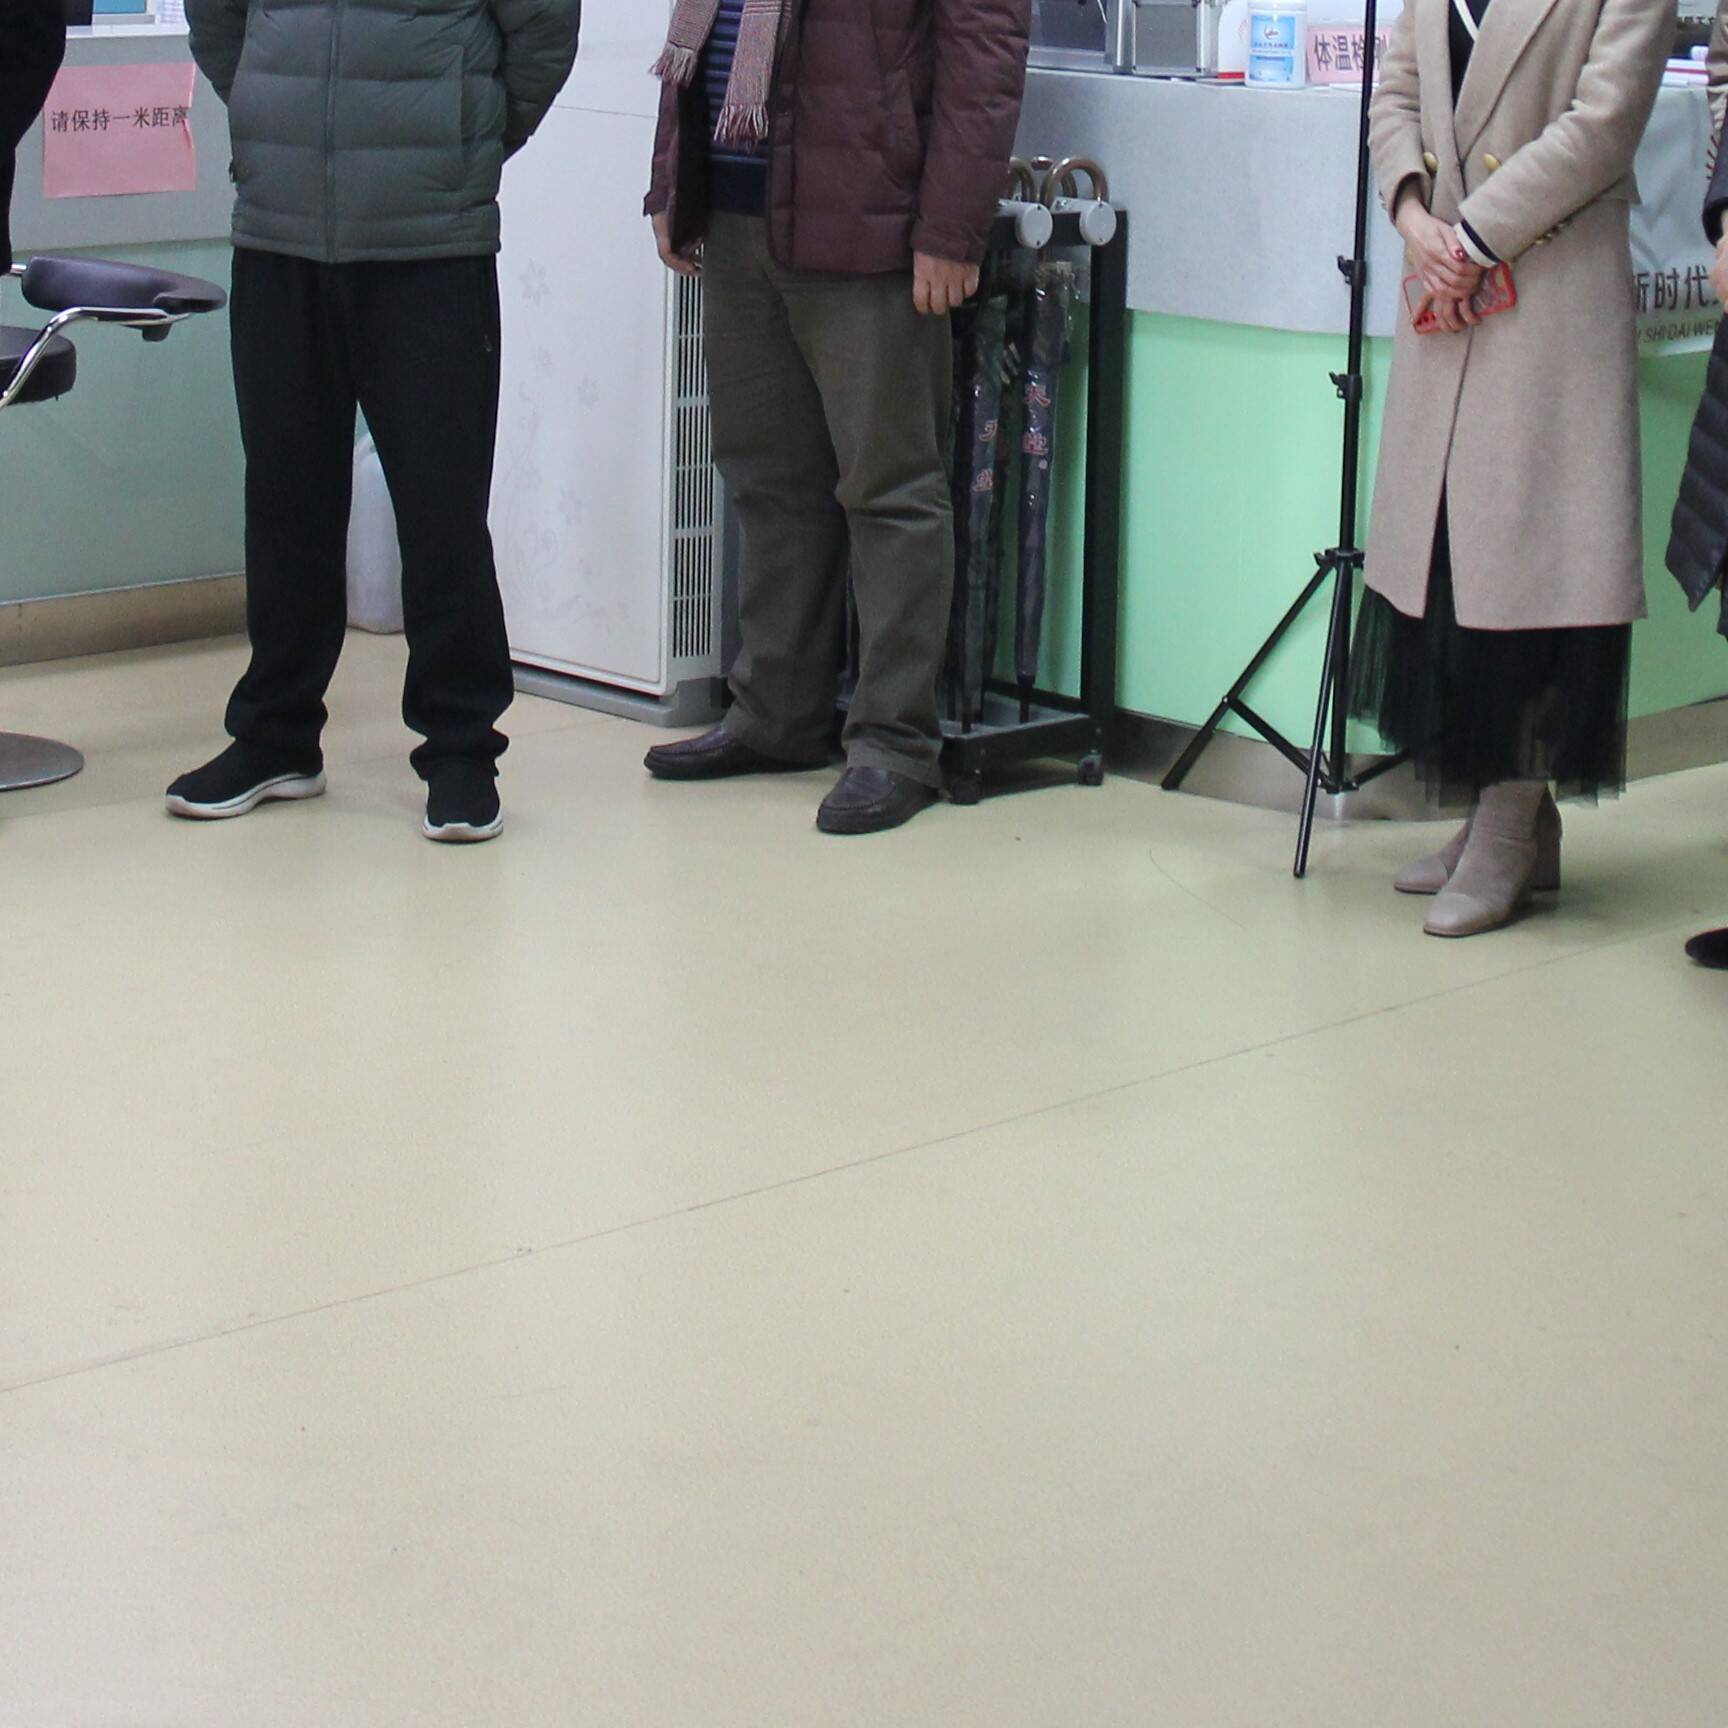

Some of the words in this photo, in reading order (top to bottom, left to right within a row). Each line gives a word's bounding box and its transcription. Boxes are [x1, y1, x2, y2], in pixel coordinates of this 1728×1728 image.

[52, 106, 190, 132] 请保持一米距离
